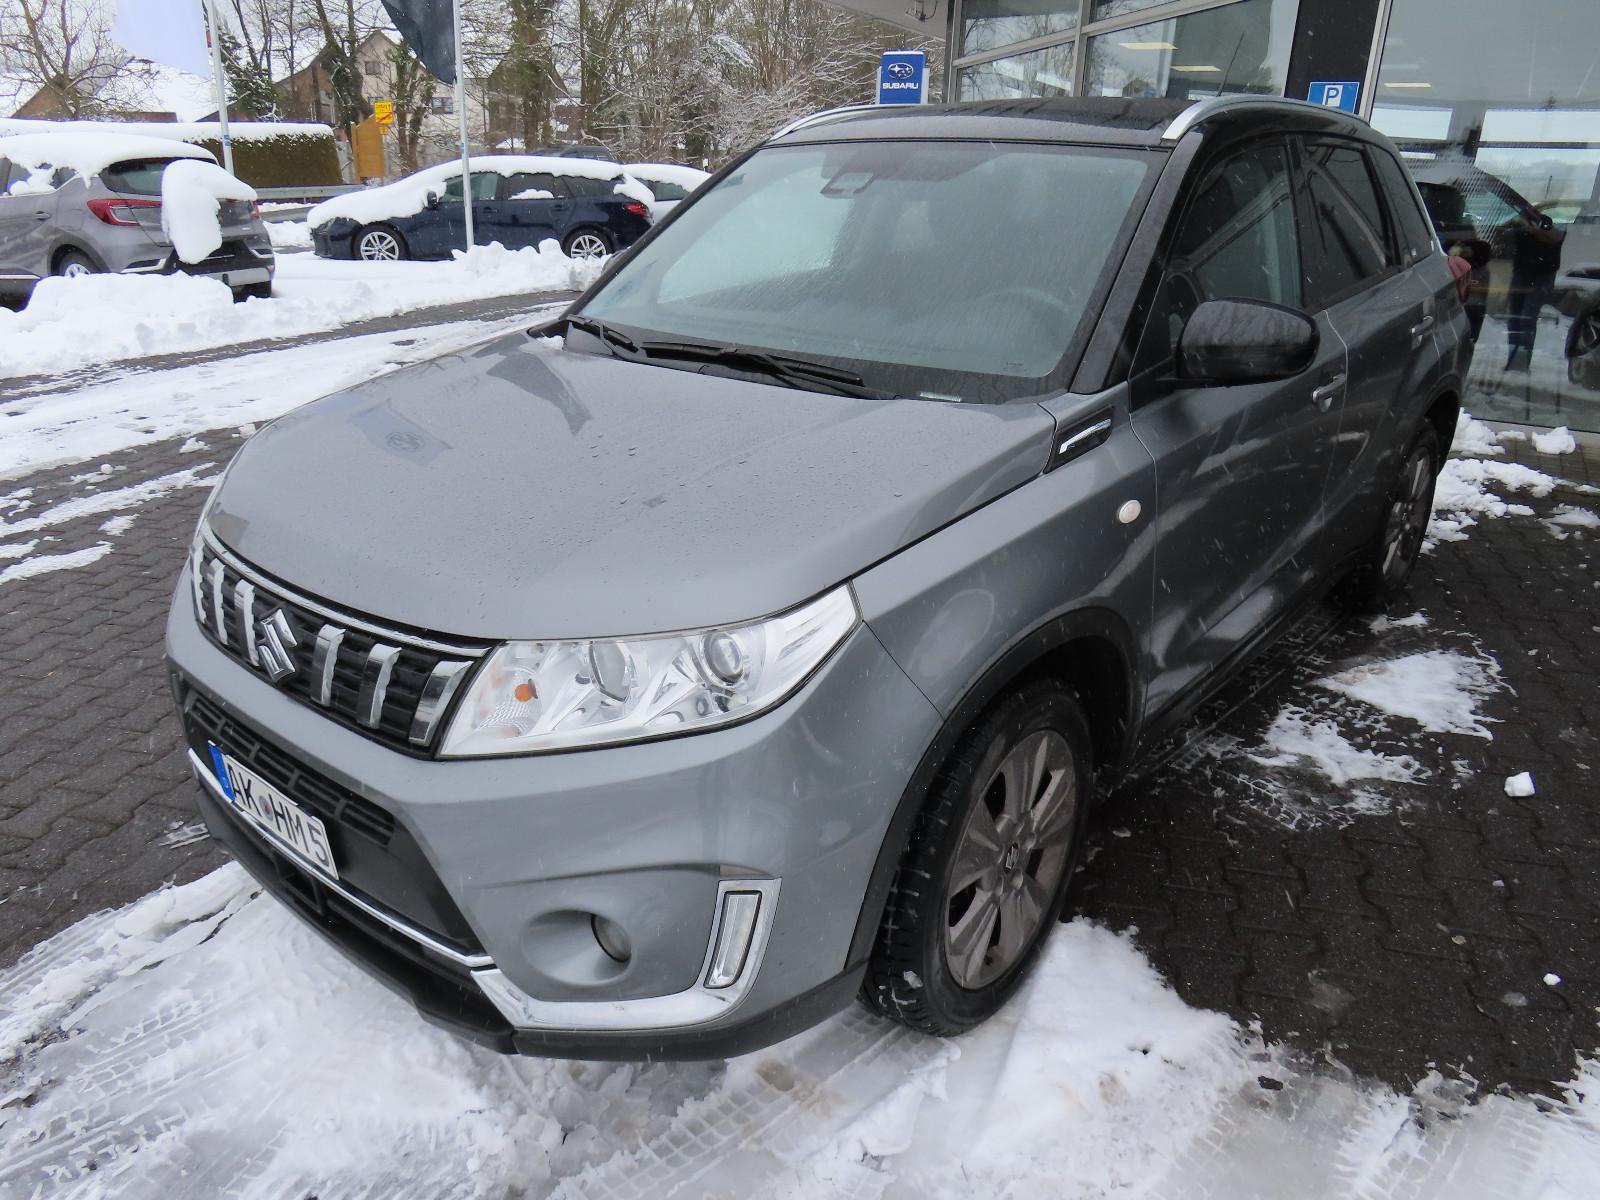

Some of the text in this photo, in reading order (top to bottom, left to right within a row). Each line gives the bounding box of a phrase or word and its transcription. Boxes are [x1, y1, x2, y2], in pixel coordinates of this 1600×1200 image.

[882, 82, 919, 90] SUBARU
[1325, 87, 1340, 106] P
[227, 764, 262, 817] AK
